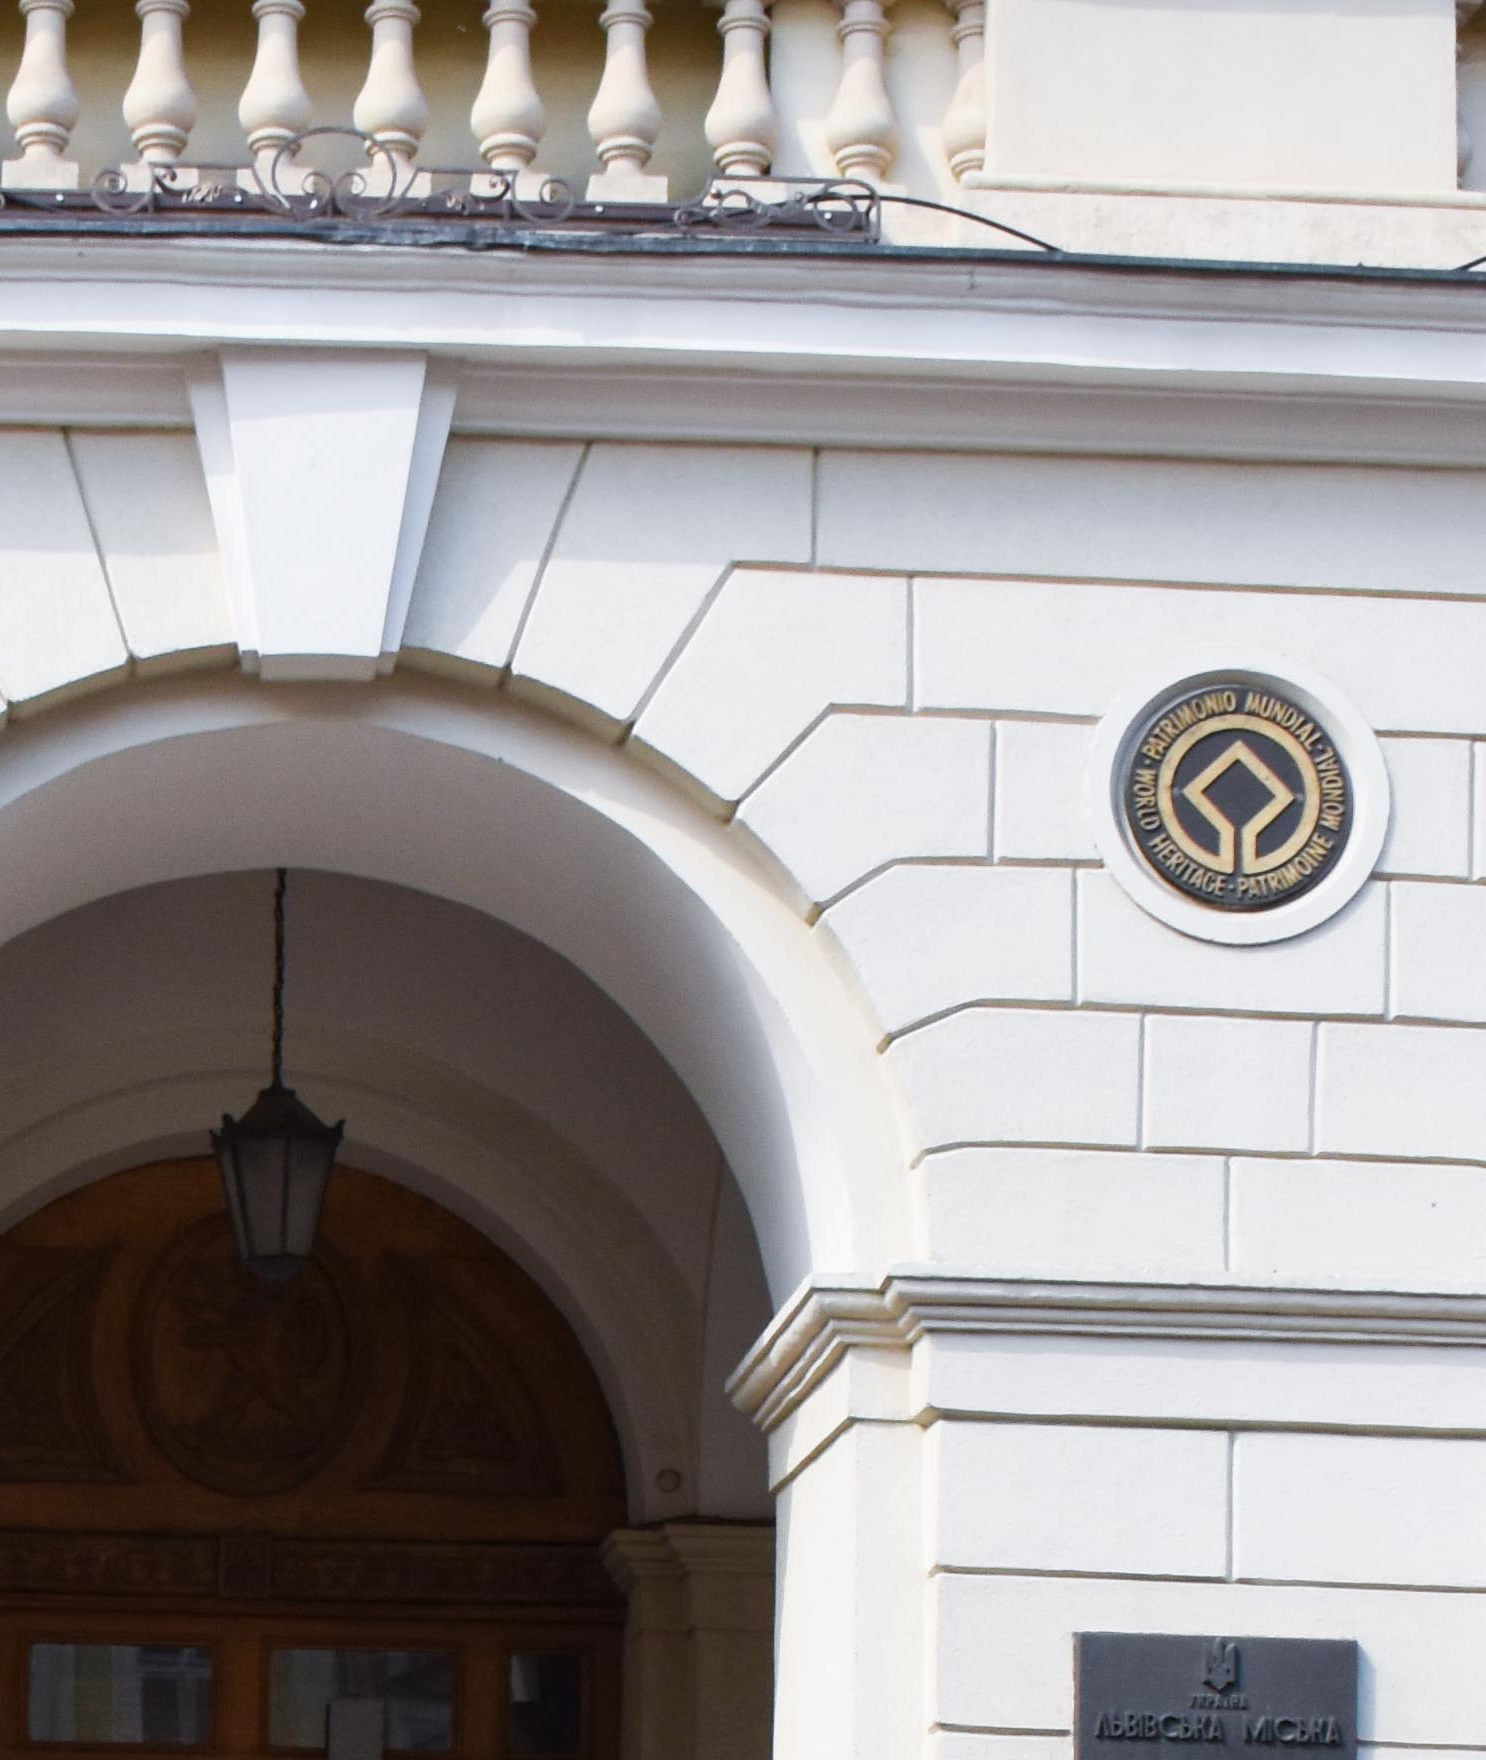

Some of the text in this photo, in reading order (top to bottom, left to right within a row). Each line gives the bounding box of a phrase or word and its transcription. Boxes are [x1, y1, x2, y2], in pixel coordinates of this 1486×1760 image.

[1142, 691, 1320, 759] PATRIMONIO MUNDIAL
[1133, 768, 1228, 896] WORLD HERITAGE
[1238, 746, 1345, 898] PATRIMOINE MONDIAL
[1094, 1712, 1343, 1744] ЛЬВІВСЬКА МІСЬКА
